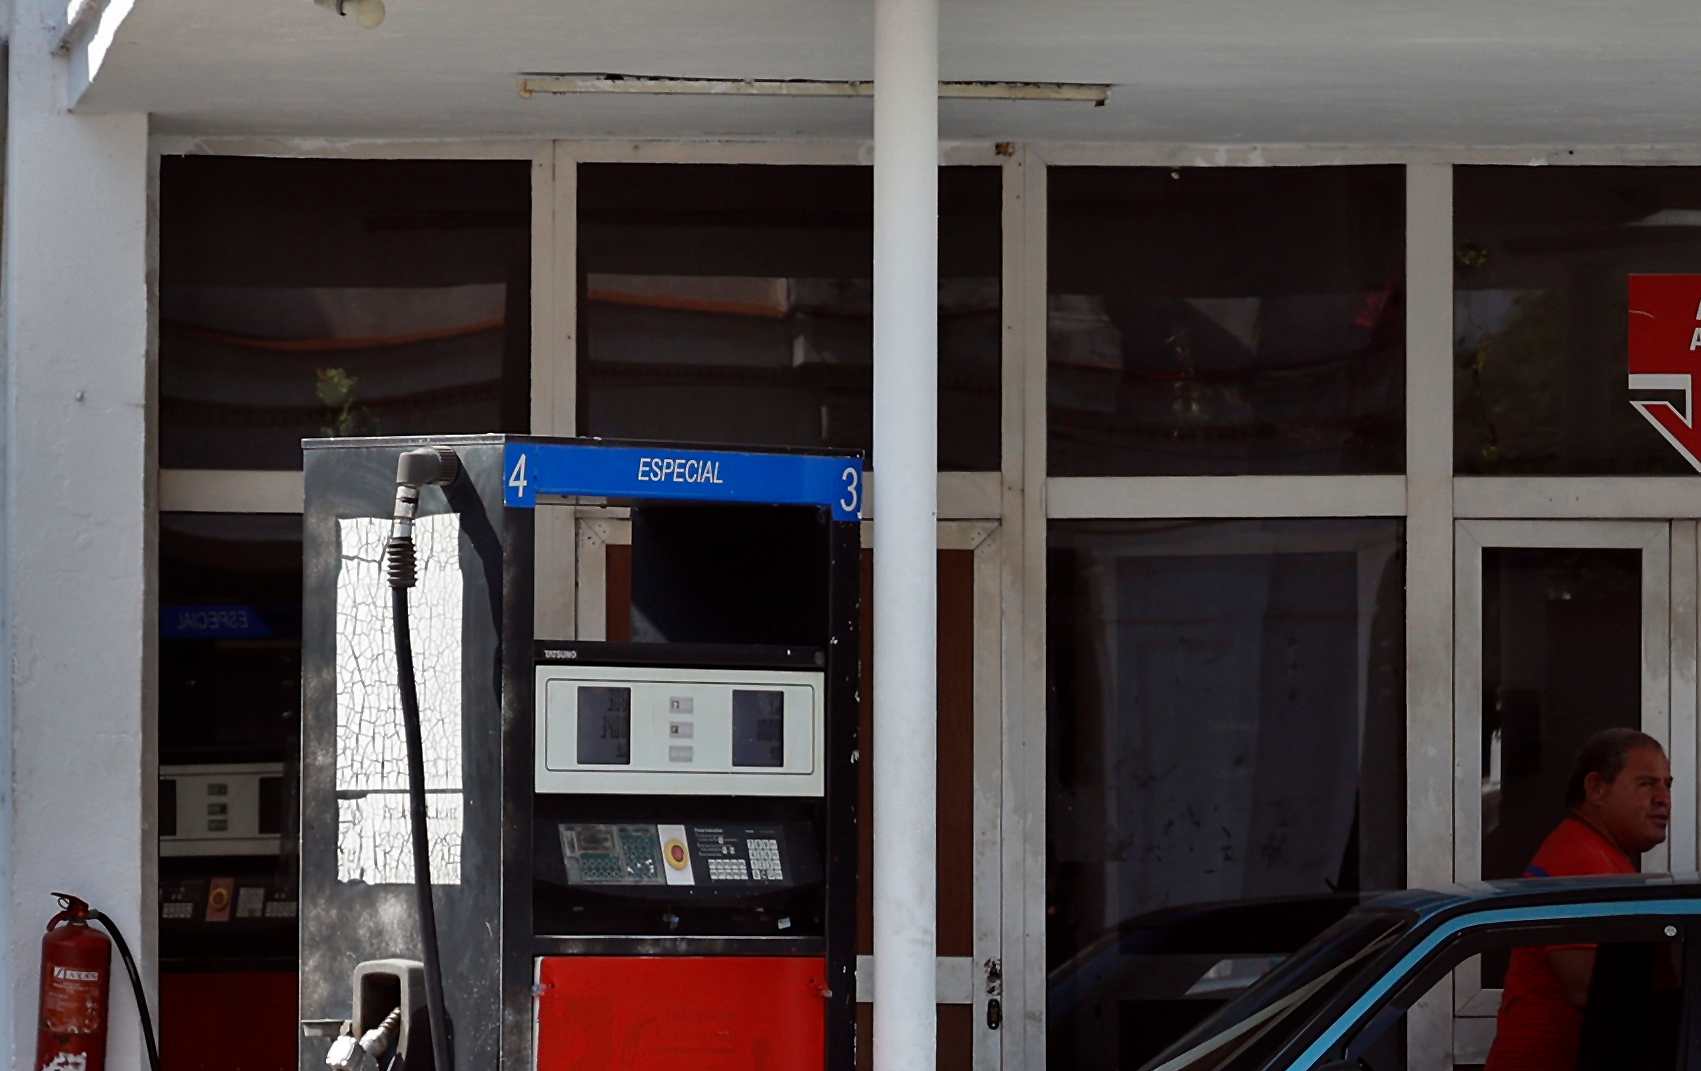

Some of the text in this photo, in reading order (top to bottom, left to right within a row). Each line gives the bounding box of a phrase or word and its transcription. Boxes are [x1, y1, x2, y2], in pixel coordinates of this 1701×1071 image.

[508, 454, 527, 497] 4
[638, 458, 723, 484] ESPECIAL
[840, 467, 858, 512] 3
